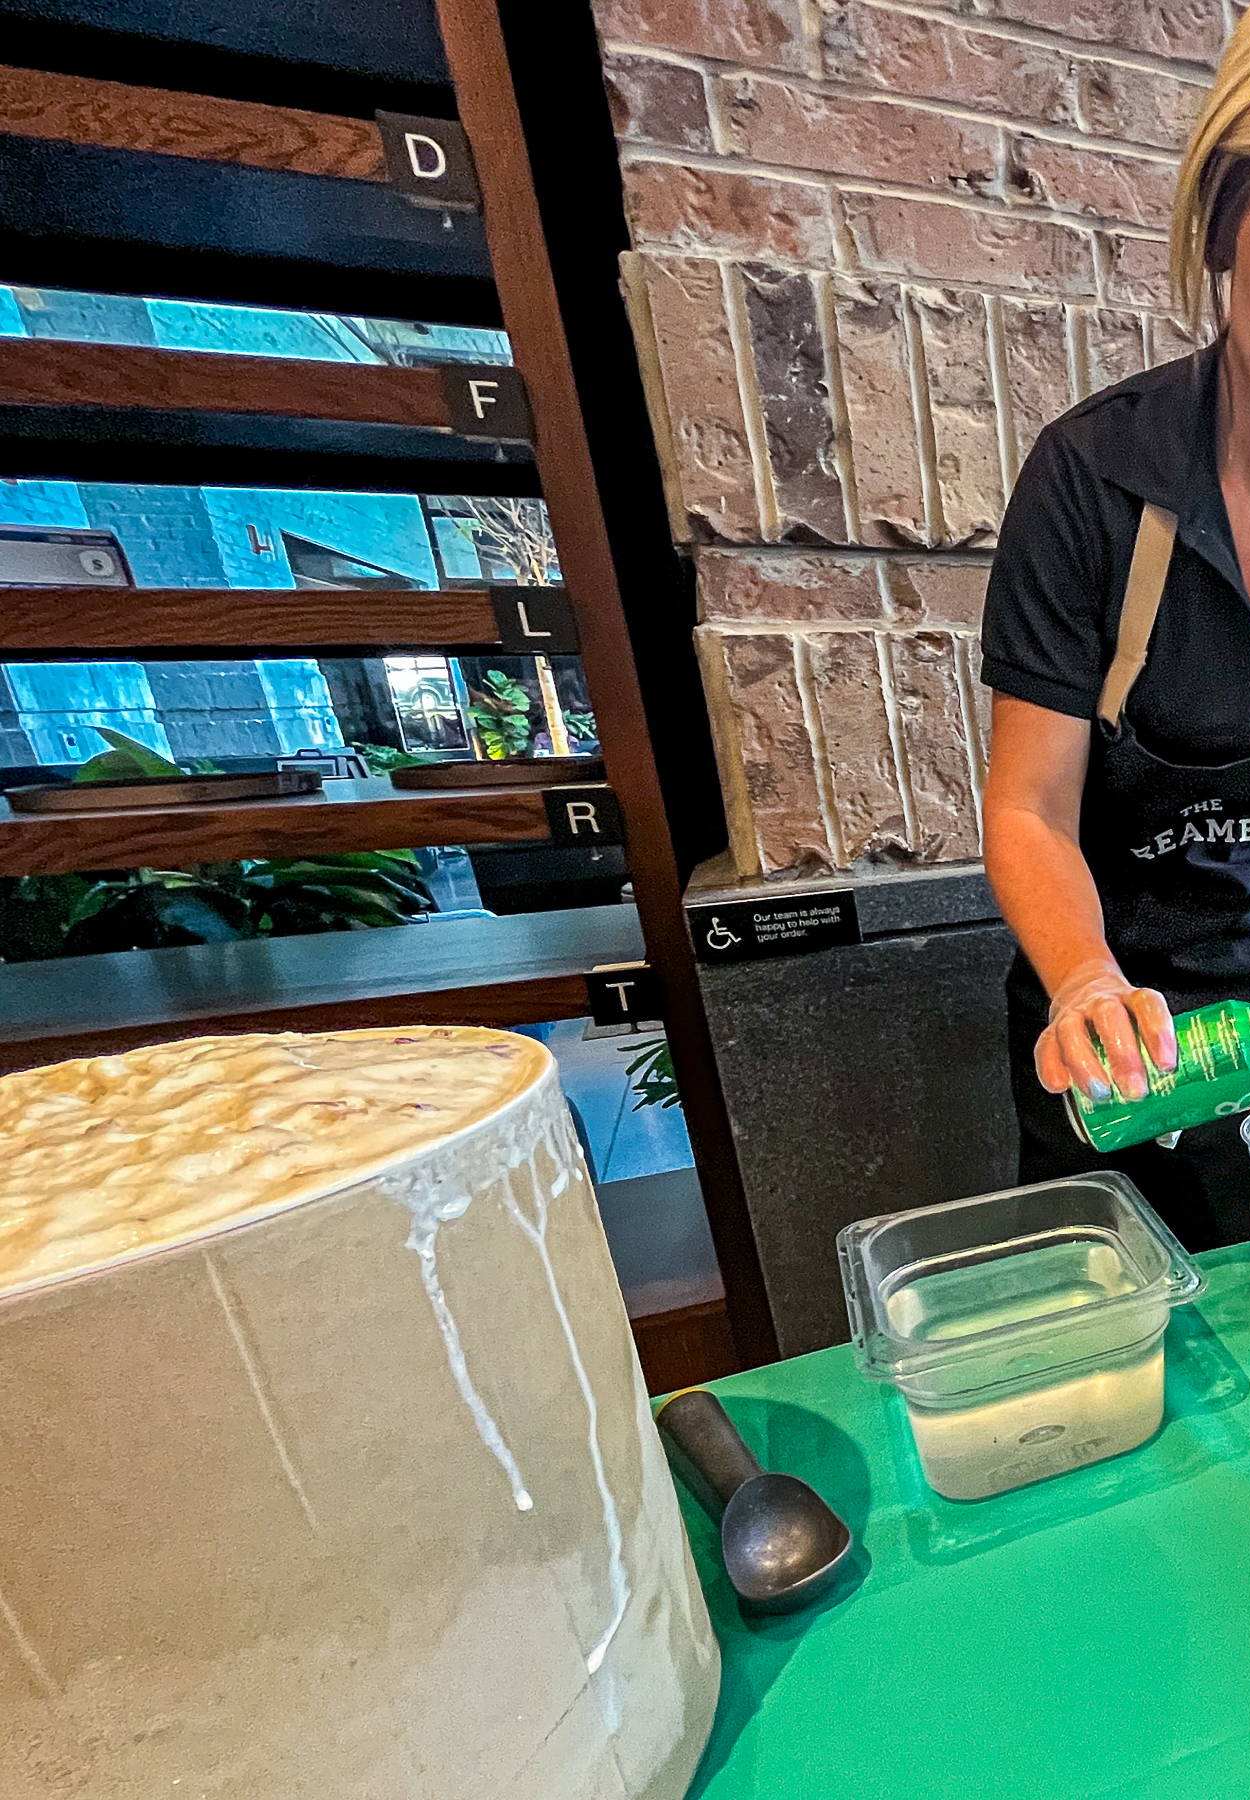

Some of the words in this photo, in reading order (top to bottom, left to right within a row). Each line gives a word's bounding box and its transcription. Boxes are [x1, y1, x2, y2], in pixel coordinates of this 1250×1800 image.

[405, 133, 446, 178] D
[468, 380, 499, 419] F
[517, 601, 552, 637] L
[566, 802, 600, 834] R
[1180, 799, 1223, 817] THE
[753, 913, 771, 922] Our
[774, 911, 799, 921] team
[800, 908, 808, 917] is
[809, 906, 840, 916] always
[755, 922, 786, 932] happy
[787, 920, 798, 929] to
[799, 918, 819, 928] help
[820, 914, 841, 925] with
[757, 932, 779, 943] your
[780, 928, 808, 939] order.
[605, 981, 635, 1012] T
